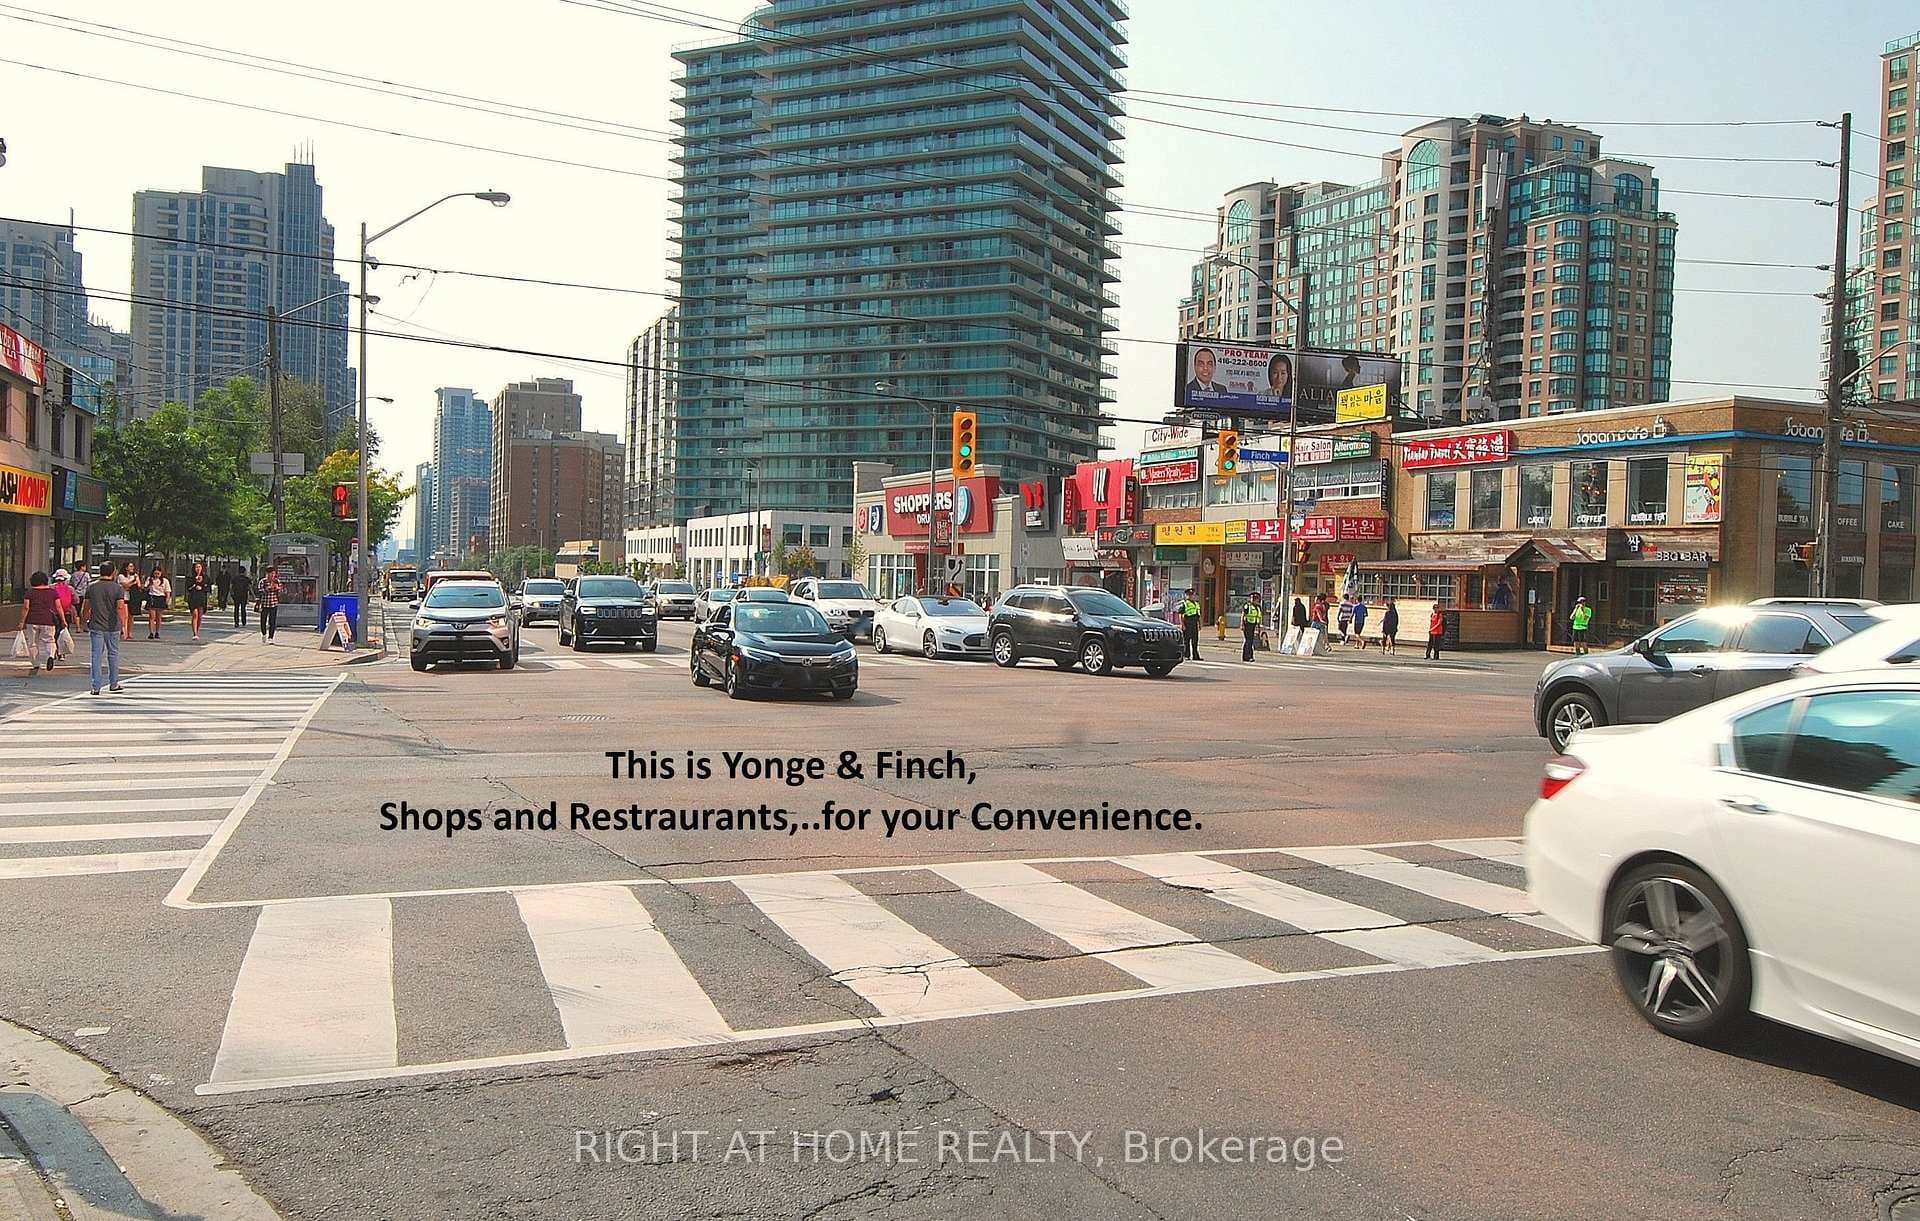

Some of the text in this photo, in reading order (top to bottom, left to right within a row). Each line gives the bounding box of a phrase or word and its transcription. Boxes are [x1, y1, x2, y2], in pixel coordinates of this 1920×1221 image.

[1224, 349, 1242, 357] PRO
[1244, 351, 1269, 359] TEAM
[1152, 425, 1189, 443] City-Wide
[1311, 438, 1332, 451] Salon
[1251, 451, 1270, 460] Finch
[1777, 514, 1798, 523] BUBBLE
[1837, 518, 1858, 527] OFFEE
[1887, 520, 1905, 529] CAKE
[1656, 551, 1679, 561] BBQ
[1684, 550, 1708, 562] BAR
